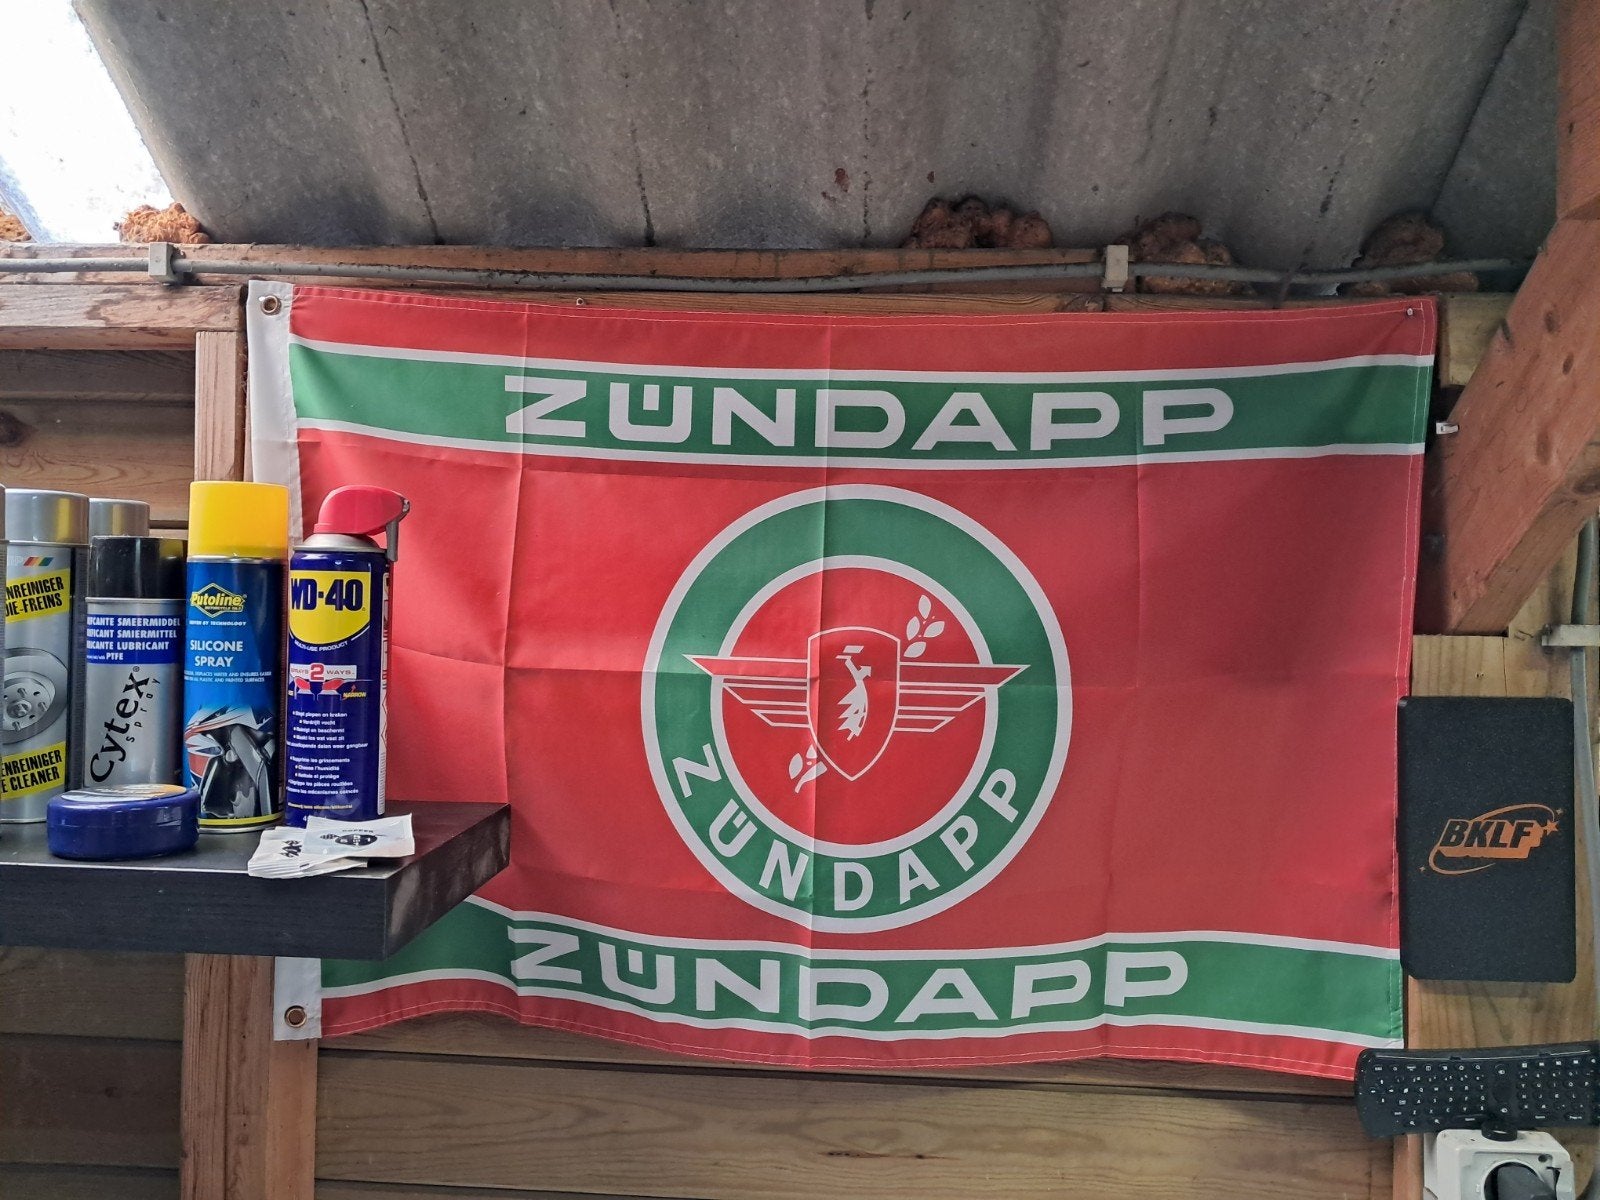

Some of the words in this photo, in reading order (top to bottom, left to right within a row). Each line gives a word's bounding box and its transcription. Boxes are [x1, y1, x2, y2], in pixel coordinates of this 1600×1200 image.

[504, 374, 1235, 452] ZÜNDAPP
[190, 593, 242, 607] Putoline
[291, 578, 363, 611] WD-40
[117, 617, 180, 627] SMEERMIDDEL
[117, 629, 177, 639] SMIERMITTEL
[117, 641, 169, 651] LUBRICANT
[190, 640, 243, 652] SILICONE
[319, 641, 349, 652] PRODUCT
[106, 652, 124, 660] PTFE
[194, 656, 234, 668] SPRAY
[90, 672, 150, 782] Cytex
[10, 766, 60, 791] CLEANER
[672, 744, 1019, 911] ZÜNDAPP
[1438, 819, 1541, 857] BKLF
[507, 926, 1188, 1023] ZÜNDAPP
